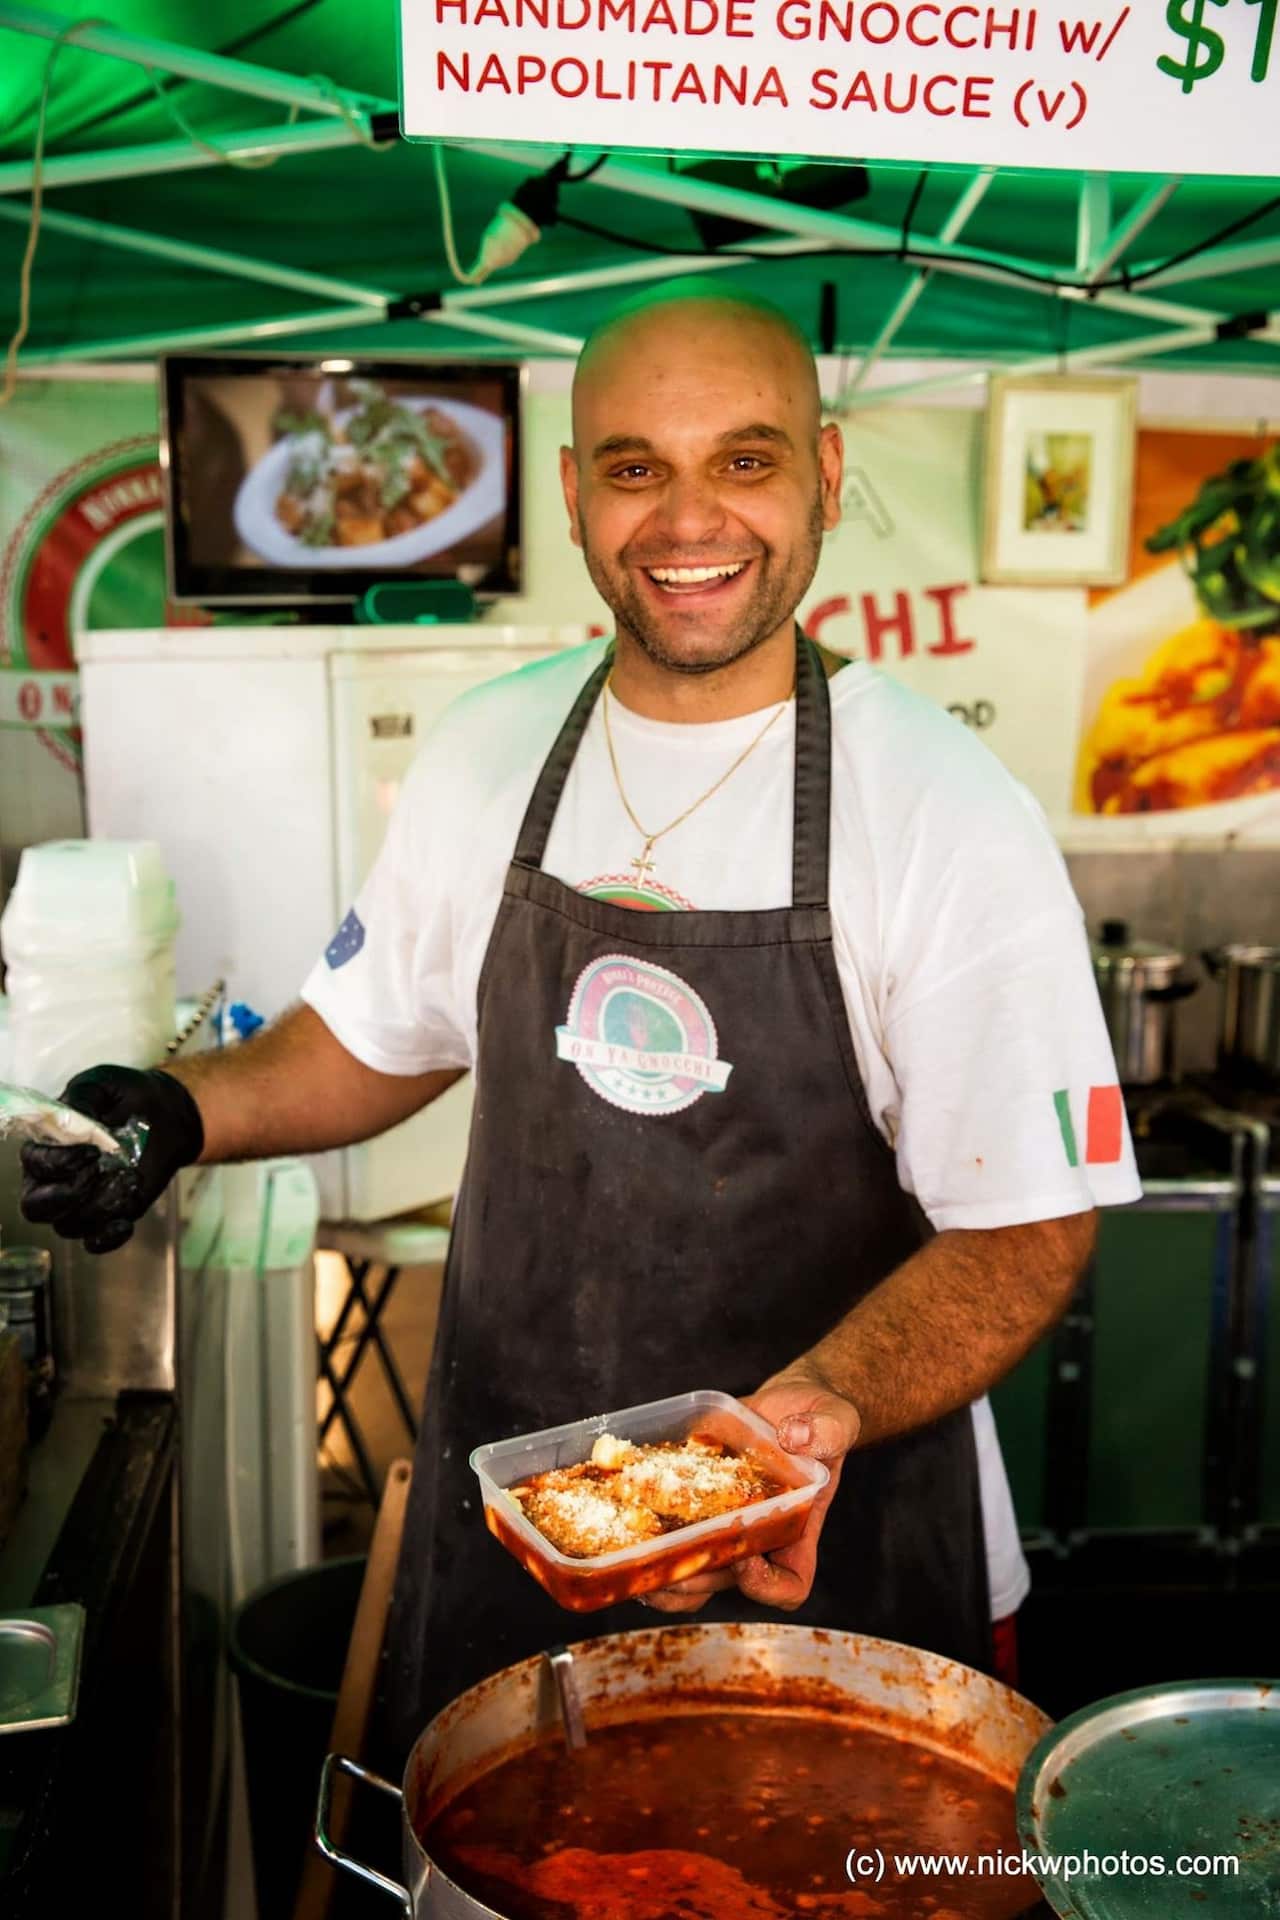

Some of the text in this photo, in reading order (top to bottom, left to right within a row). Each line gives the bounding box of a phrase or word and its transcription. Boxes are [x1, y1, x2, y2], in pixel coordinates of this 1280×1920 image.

[436, 0, 1130, 61] HANDMADE GNOCCHI w/
[436, 50, 1088, 130] NAPOLITANA SAUCE (v)
